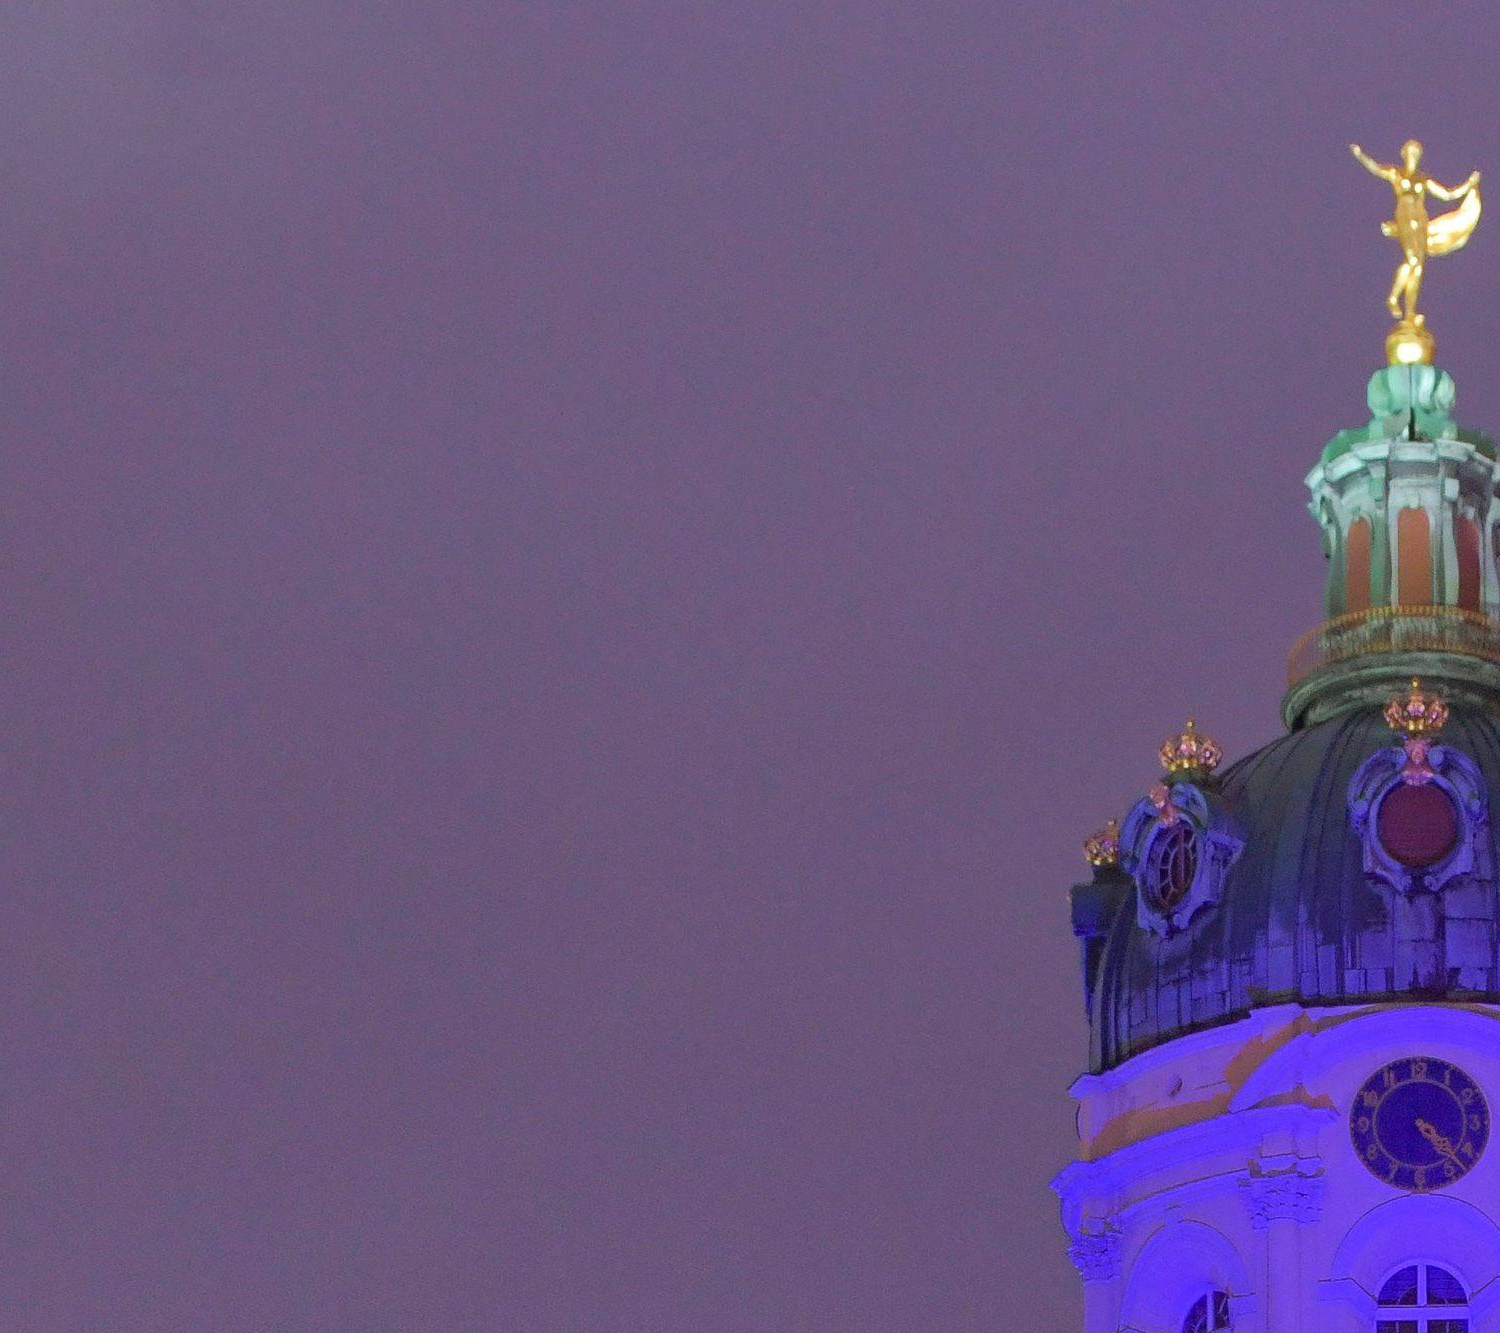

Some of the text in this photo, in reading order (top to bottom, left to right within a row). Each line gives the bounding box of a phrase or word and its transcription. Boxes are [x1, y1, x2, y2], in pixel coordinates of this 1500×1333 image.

[1411, 1062, 1428, 1081] 12
[1460, 1088, 1473, 1104] 2
[1357, 1116, 1370, 1133] 9
[1468, 1114, 1480, 1131] 3
[1367, 1143, 1378, 1160] 8
[1460, 1142, 1473, 1158] 4
